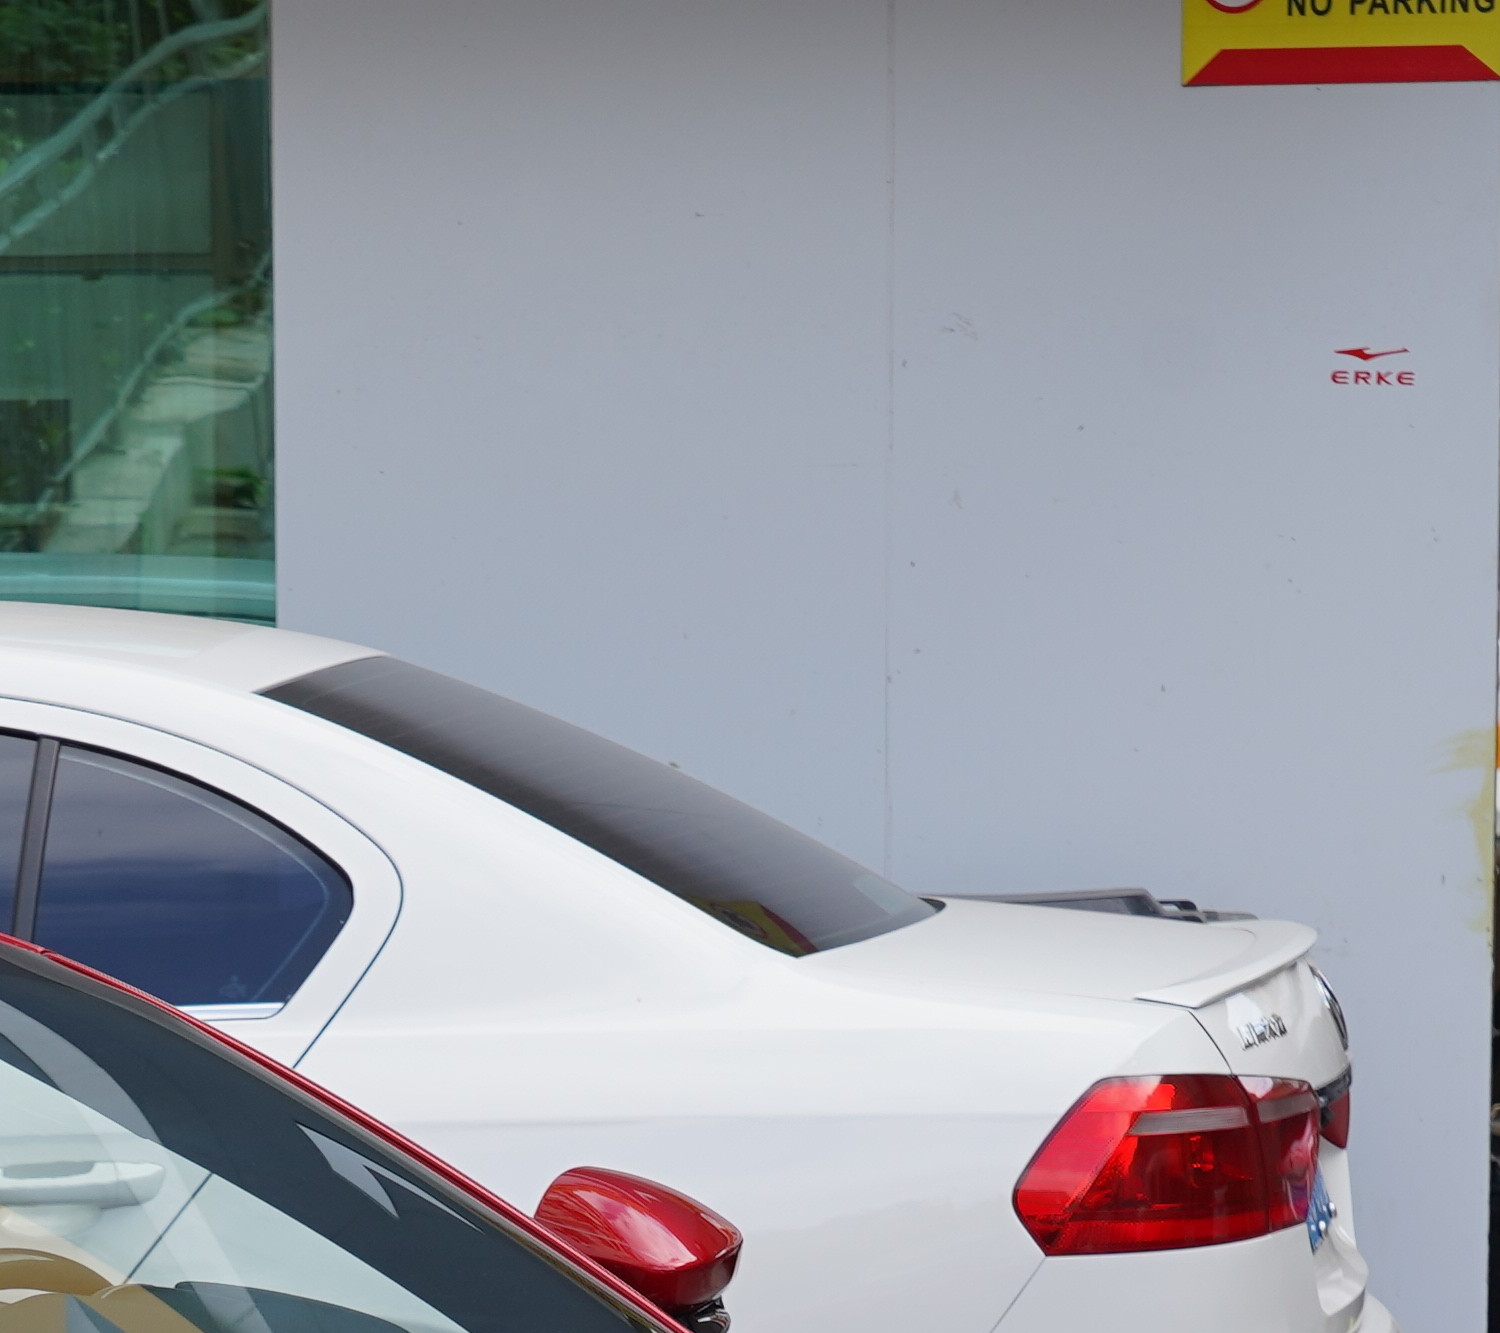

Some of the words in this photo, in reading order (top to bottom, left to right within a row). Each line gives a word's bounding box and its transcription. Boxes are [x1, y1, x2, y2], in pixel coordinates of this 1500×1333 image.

[1287, 0, 1334, 16] NO
[1349, 0, 1496, 15] PARKING
[1330, 370, 1416, 386] ERKE
